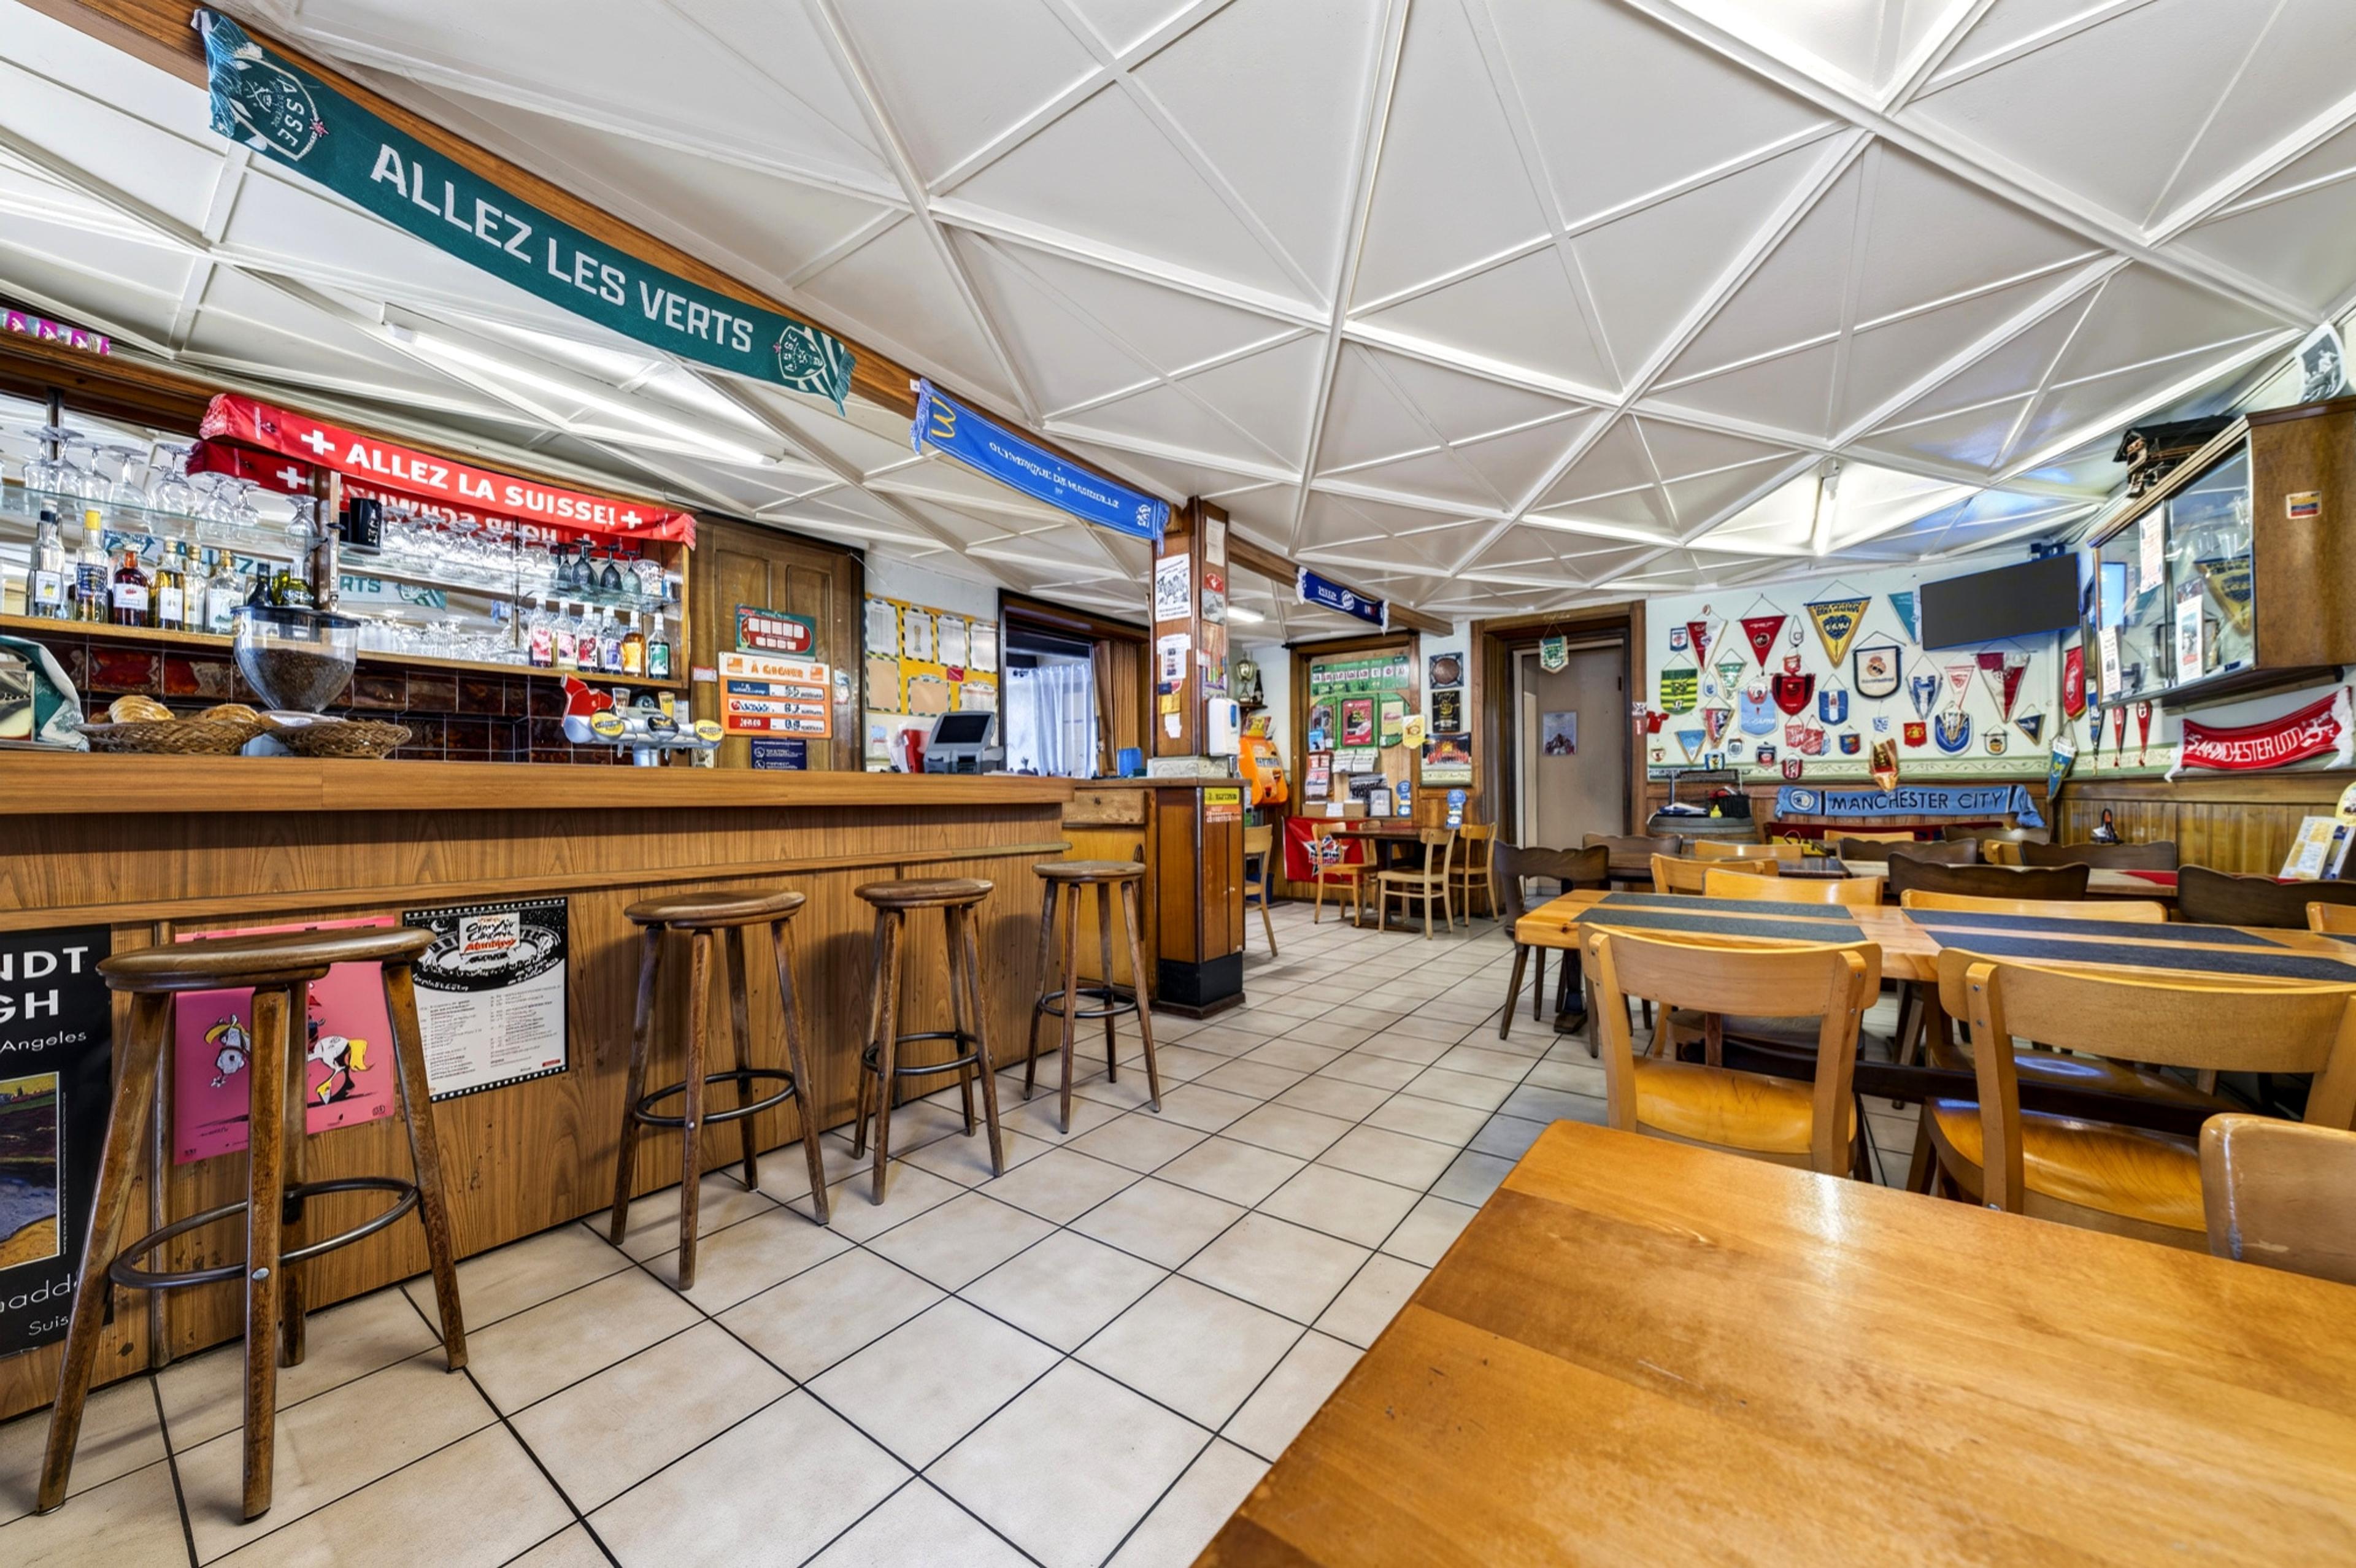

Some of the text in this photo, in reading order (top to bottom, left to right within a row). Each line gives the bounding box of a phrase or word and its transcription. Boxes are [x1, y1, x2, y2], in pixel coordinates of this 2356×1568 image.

[370, 143, 753, 353] ALLEZ LES VERTS
[345, 442, 616, 526] ALLEZ LA SUISSE!
[340, 575, 381, 593] RTS
[1831, 791, 2006, 812] MANCHESTER CITY
[0, 1030, 87, 1053] Angeles
